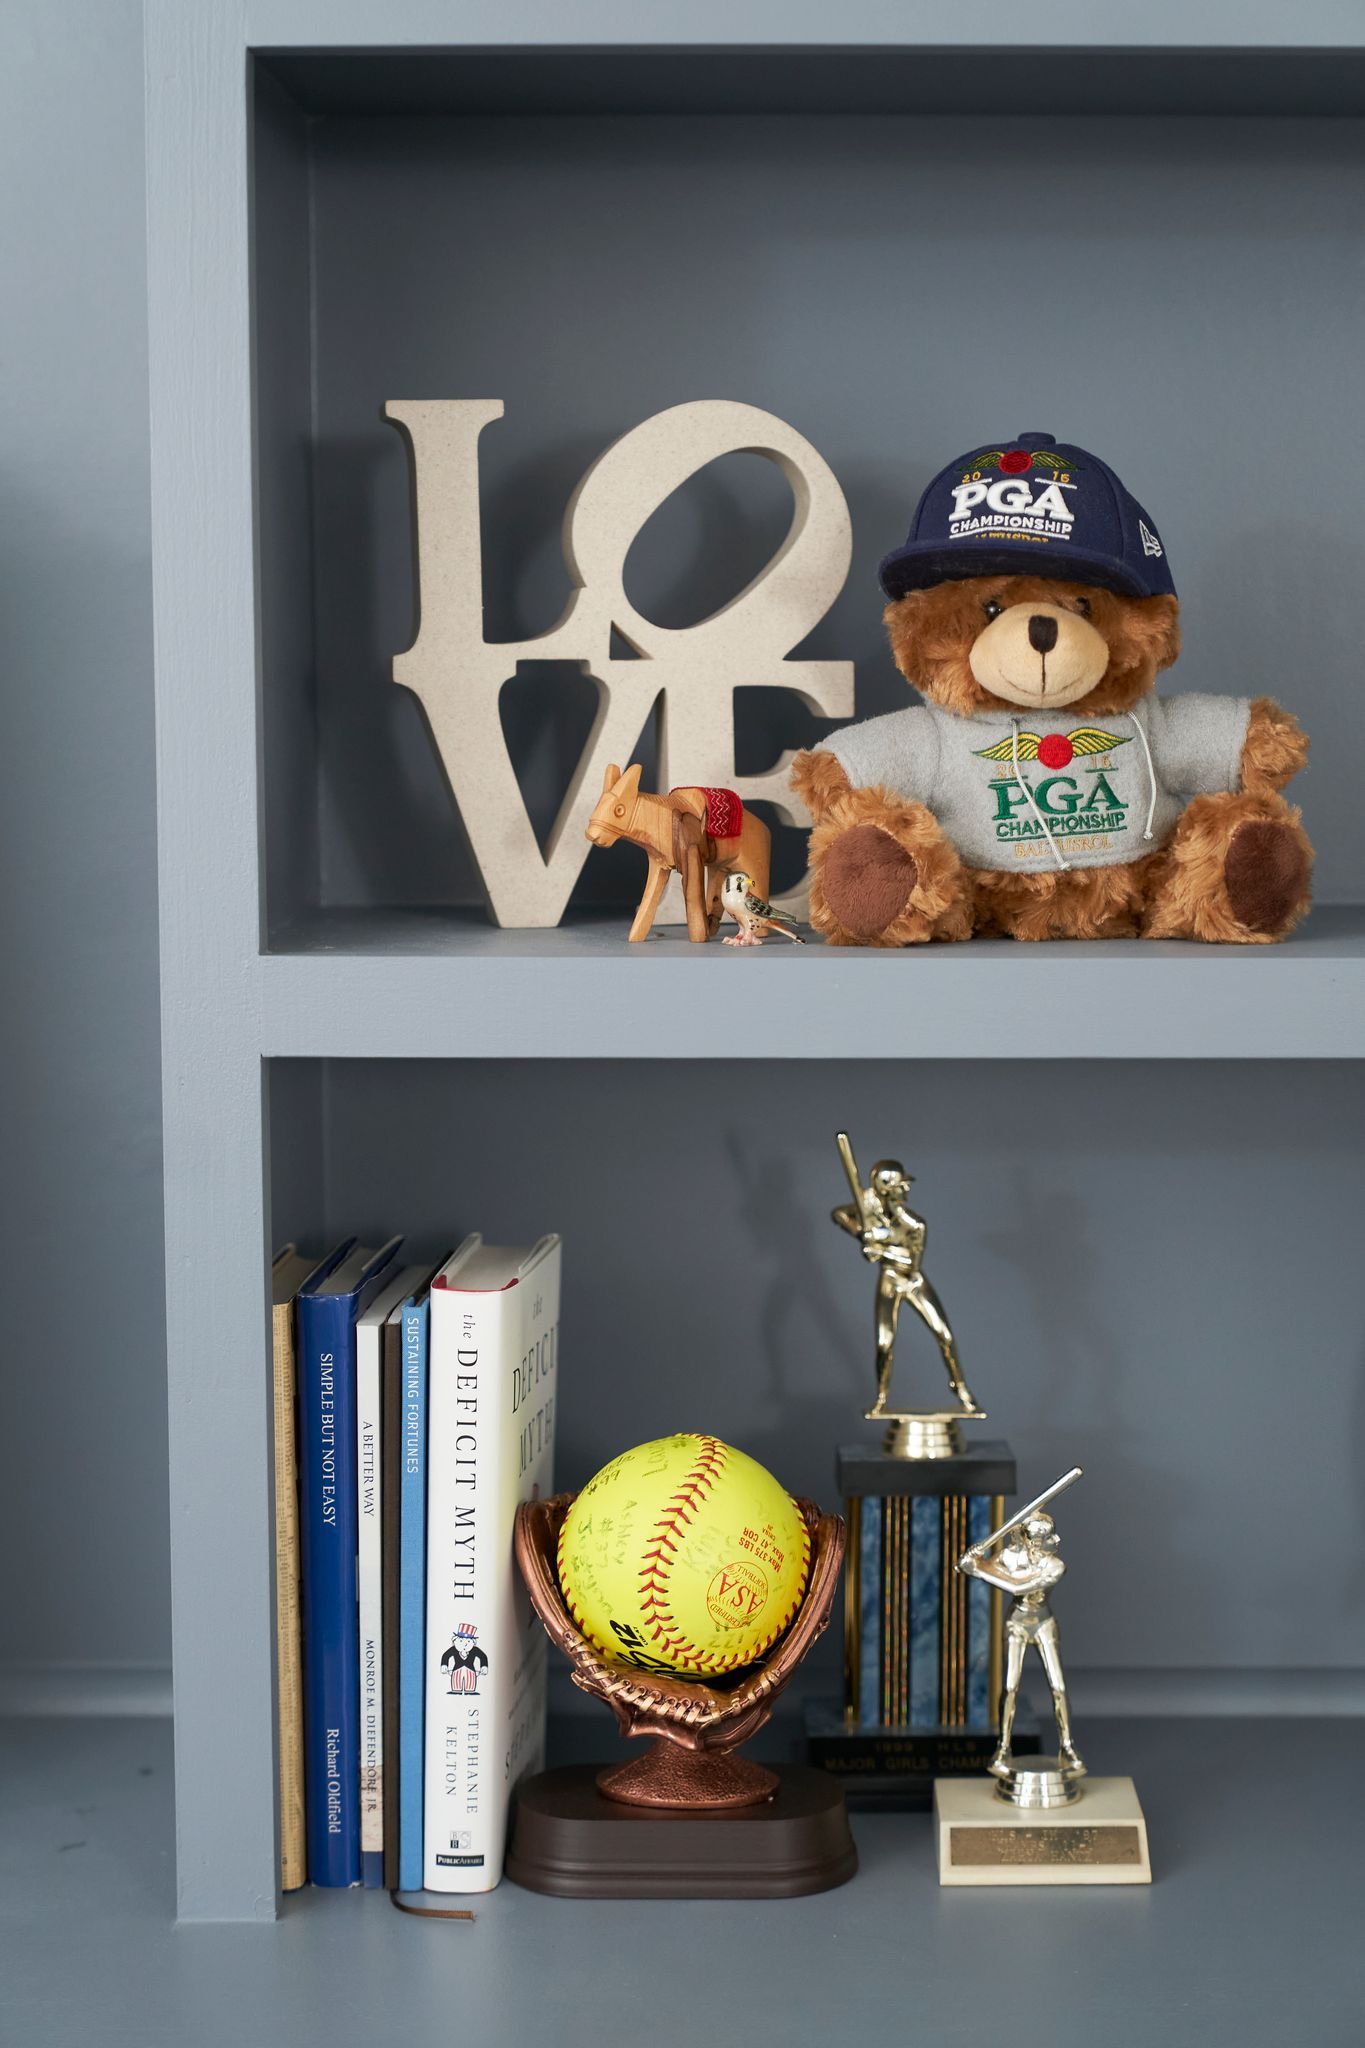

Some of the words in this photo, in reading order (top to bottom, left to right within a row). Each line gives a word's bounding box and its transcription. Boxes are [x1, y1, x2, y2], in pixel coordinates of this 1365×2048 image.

[948, 478, 1075, 522] PGA
[950, 515, 1073, 534] CHAMPIONSHIP
[987, 773, 1129, 821] PGA
[995, 811, 1126, 838] CHAMPIONSHIP
[463, 1313, 475, 1339] the
[406, 1316, 420, 1399] SUSTAINING
[320, 1352, 335, 1411] SIMPLE
[321, 1413, 335, 1445] BUT
[362, 1420, 374, 1430] A
[406, 1404, 420, 1474] FORTUNES
[455, 1348, 479, 1491] DEFICIT
[322, 1448, 335, 1483] NOT
[362, 1433, 374, 1484] BETTER
[322, 1485, 336, 1527] EASY
[363, 1487, 375, 1517] WAY
[453, 1505, 477, 1600] MYTH
[738, 1536, 756, 1551] LBS
[742, 1526, 760, 1541] COR
[754, 1547, 769, 1560] 375
[737, 1564, 766, 1591] SOFTBALL
[767, 1556, 782, 1574] Max
[719, 1572, 765, 1615] ASA
[365, 1638, 377, 1694] MONROE
[366, 1697, 377, 1712] M.
[326, 1728, 341, 1778] Richard
[445, 1726, 458, 1797] KELTON
[465, 1708, 480, 1815] STEPHANIE
[327, 1781, 342, 1835] Oldfield
